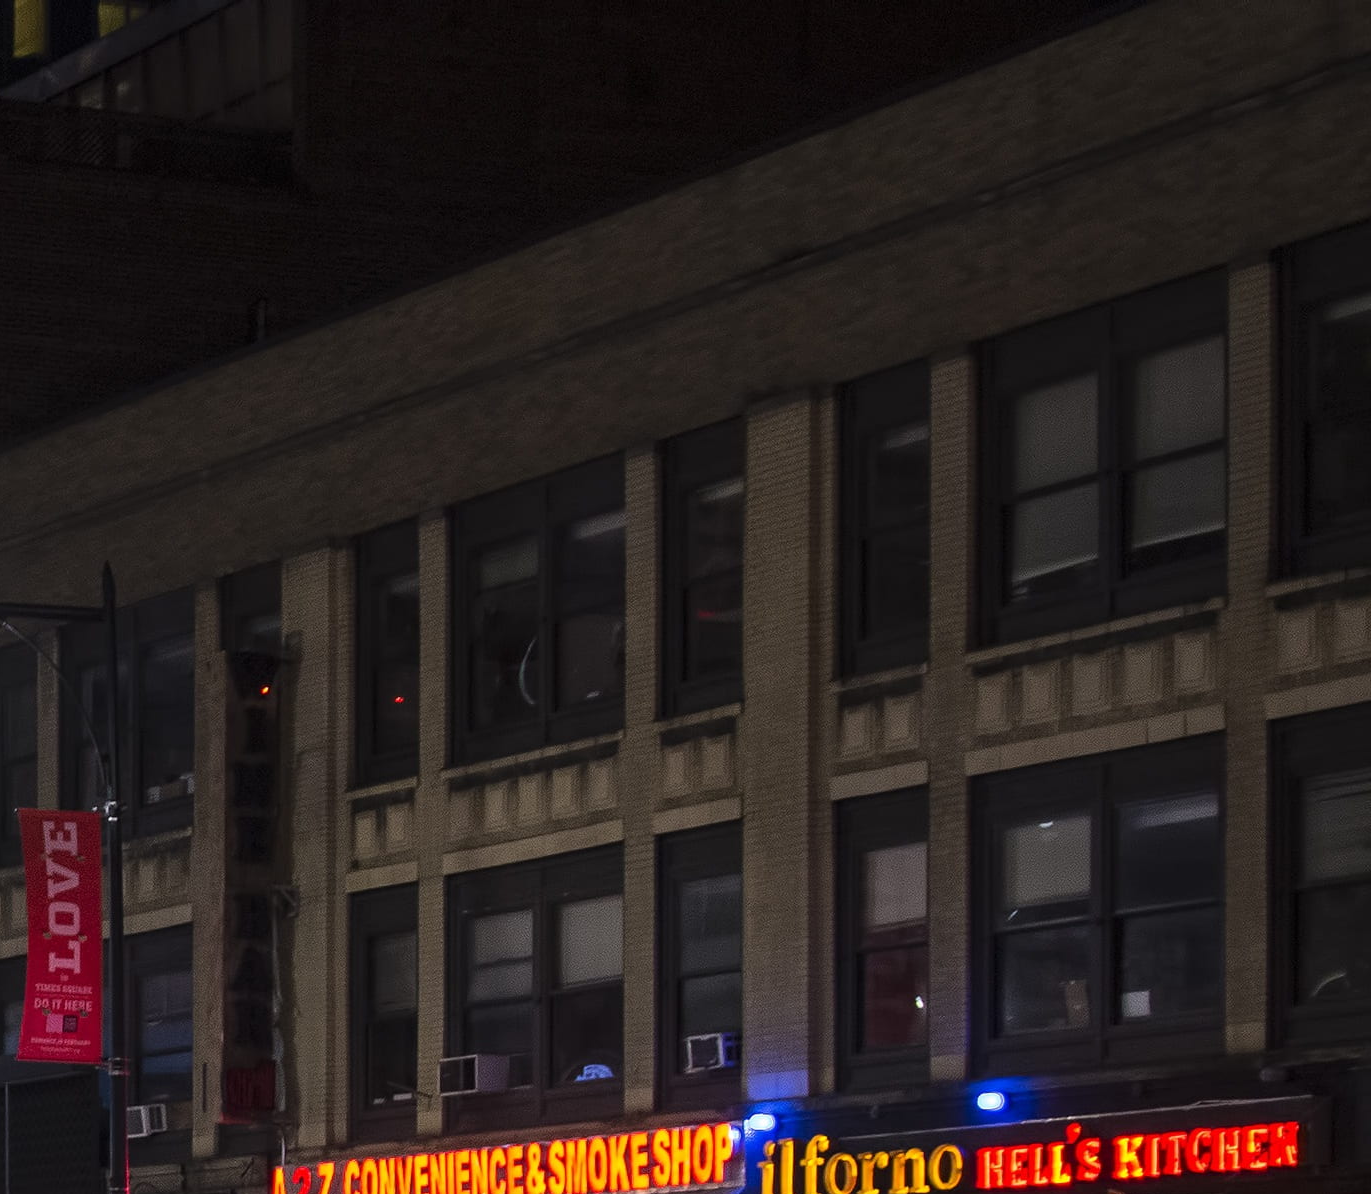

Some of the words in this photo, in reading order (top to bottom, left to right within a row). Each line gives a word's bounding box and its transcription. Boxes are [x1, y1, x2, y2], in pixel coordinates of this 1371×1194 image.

[42, 820, 82, 975] LOVE
[34, 997, 50, 1010] DO
[51, 998, 62, 1011] IT
[64, 999, 93, 1013] HERE
[652, 1121, 733, 1189] SHOP
[975, 1121, 1101, 1190] HELL'S
[1111, 1120, 1300, 1180] KITCHEN
